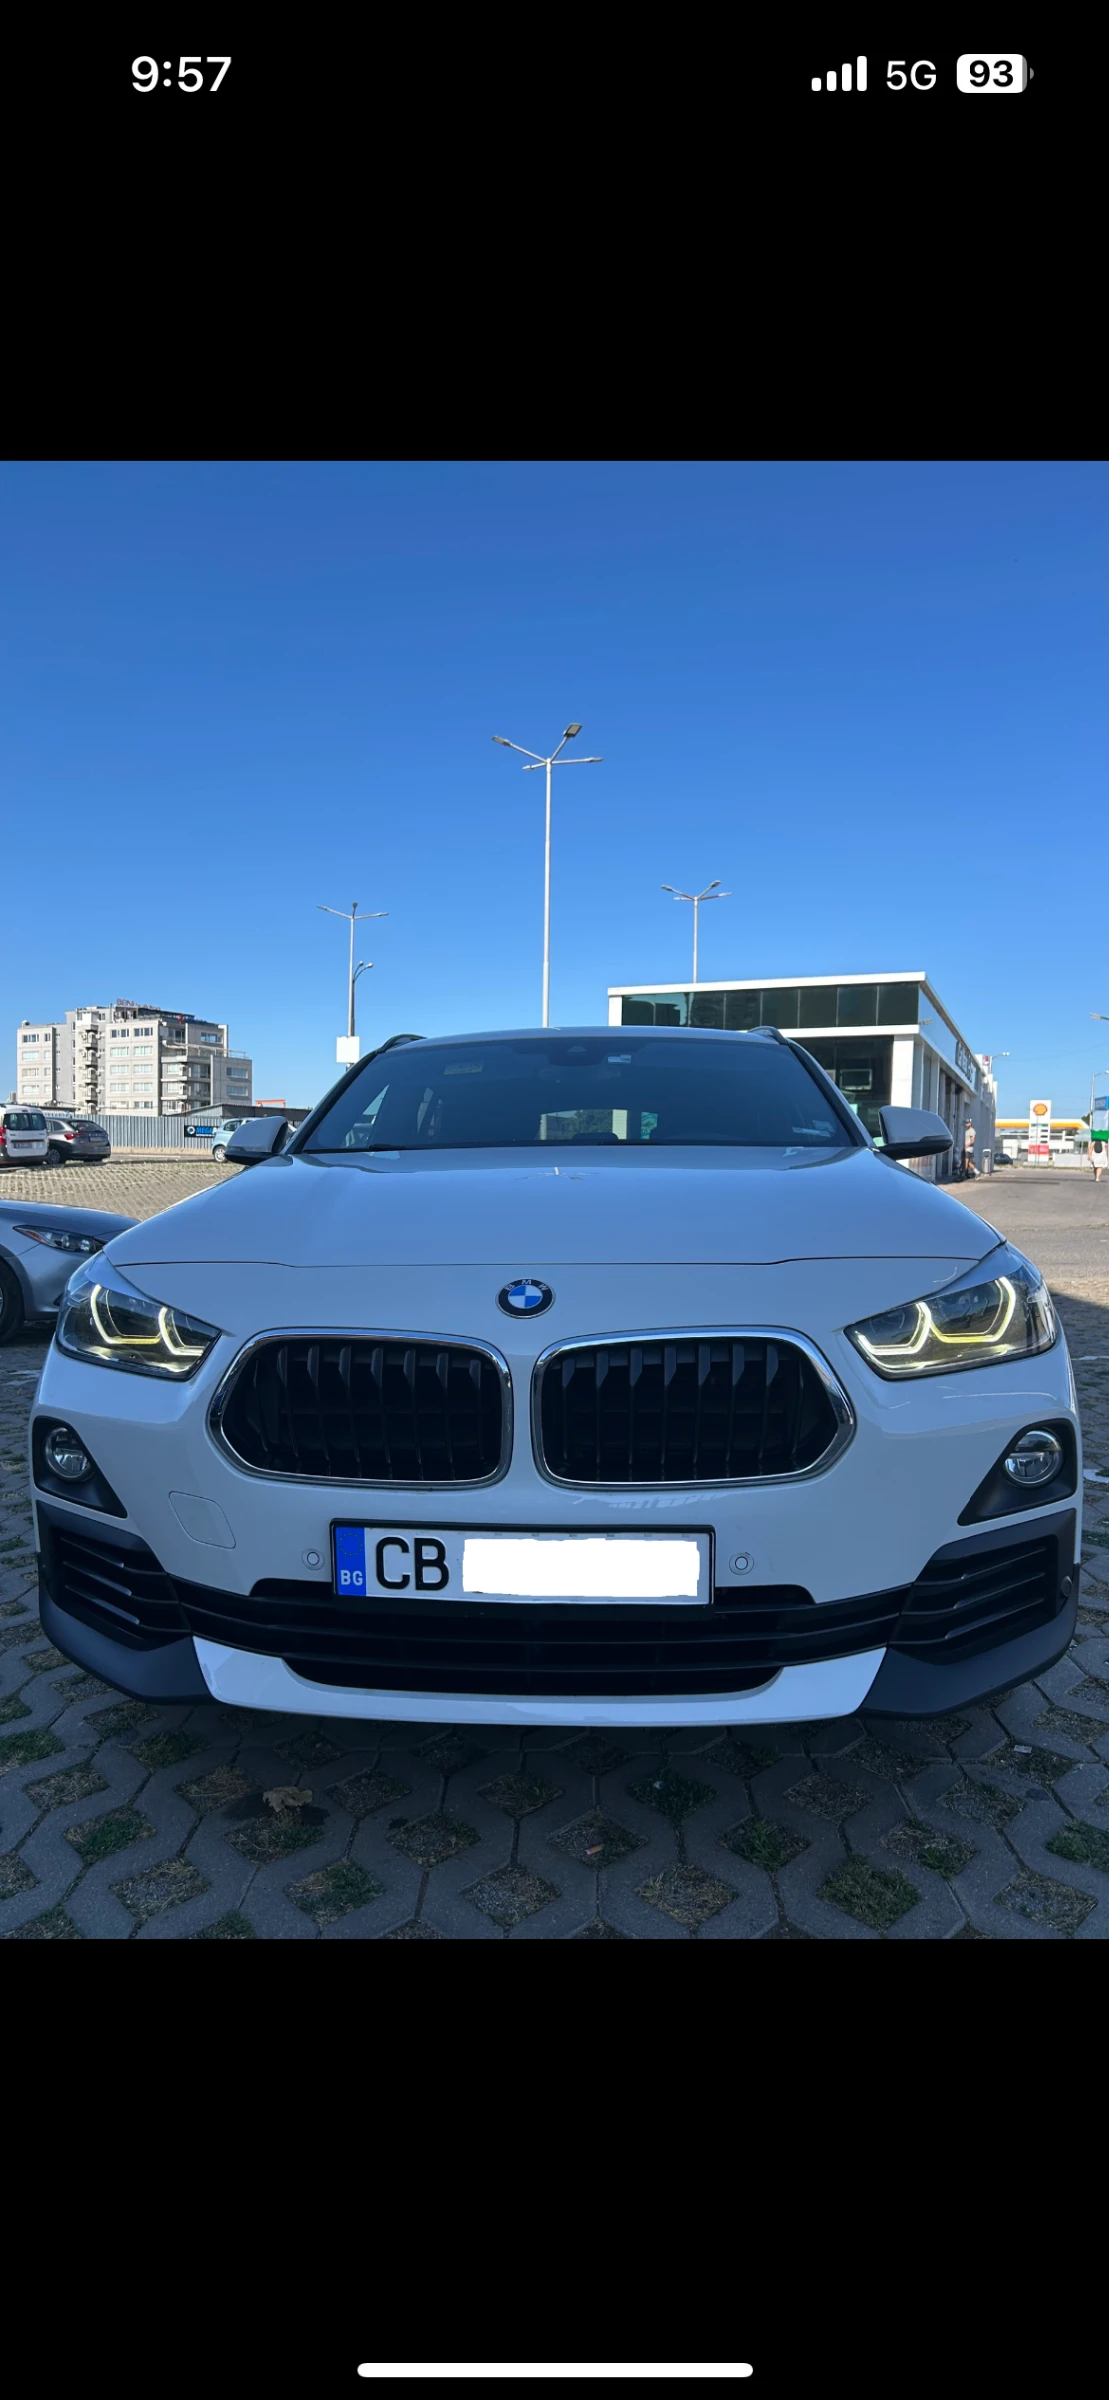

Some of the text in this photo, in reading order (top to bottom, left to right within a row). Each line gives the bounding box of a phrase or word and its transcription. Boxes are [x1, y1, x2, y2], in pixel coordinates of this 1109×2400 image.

[504, 1279, 549, 1291] BMW
[375, 1536, 450, 1591] CB
[340, 1569, 363, 1586] BG
